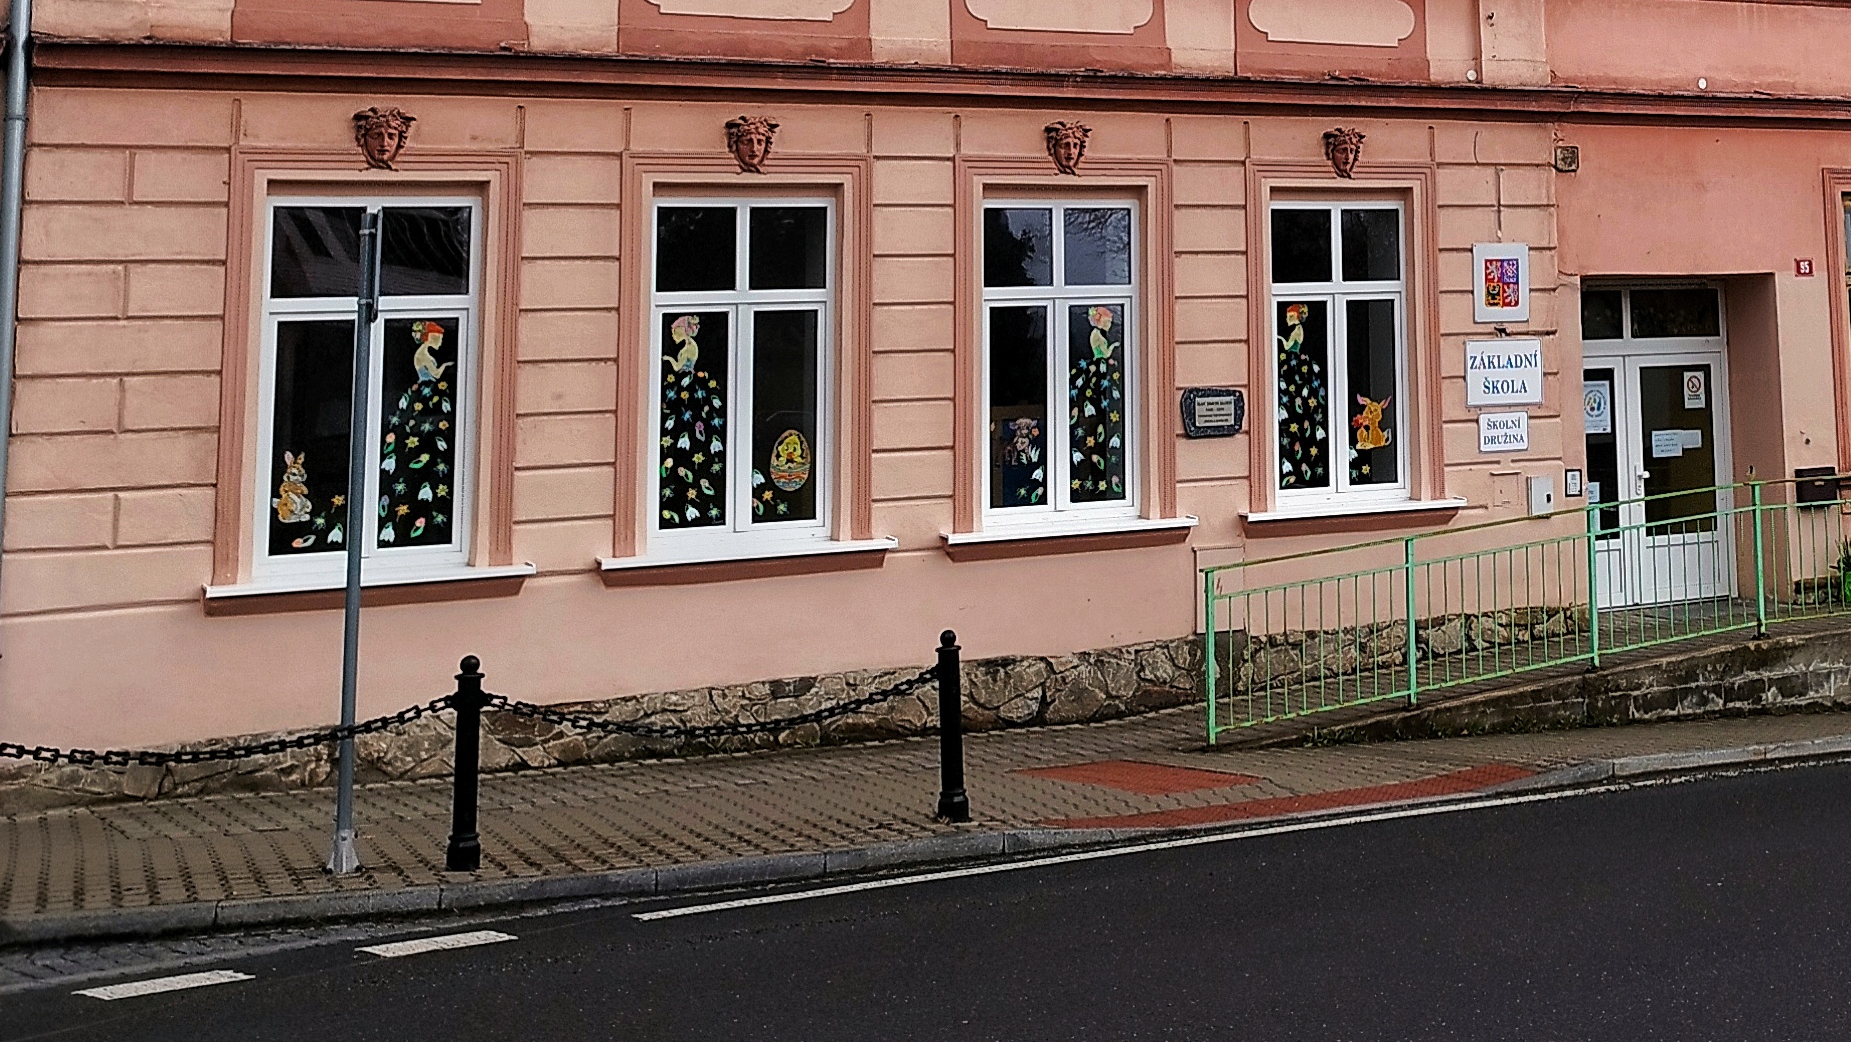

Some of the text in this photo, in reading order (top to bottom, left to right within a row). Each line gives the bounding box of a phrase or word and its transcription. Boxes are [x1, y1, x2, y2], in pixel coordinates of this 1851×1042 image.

[1469, 349, 1538, 370] ZÁKLADNÍ
[1482, 376, 1528, 395] ŠKOLA
[1486, 416, 1521, 430] ŠKOLNÍ
[1483, 432, 1525, 445] DRUŽINA
